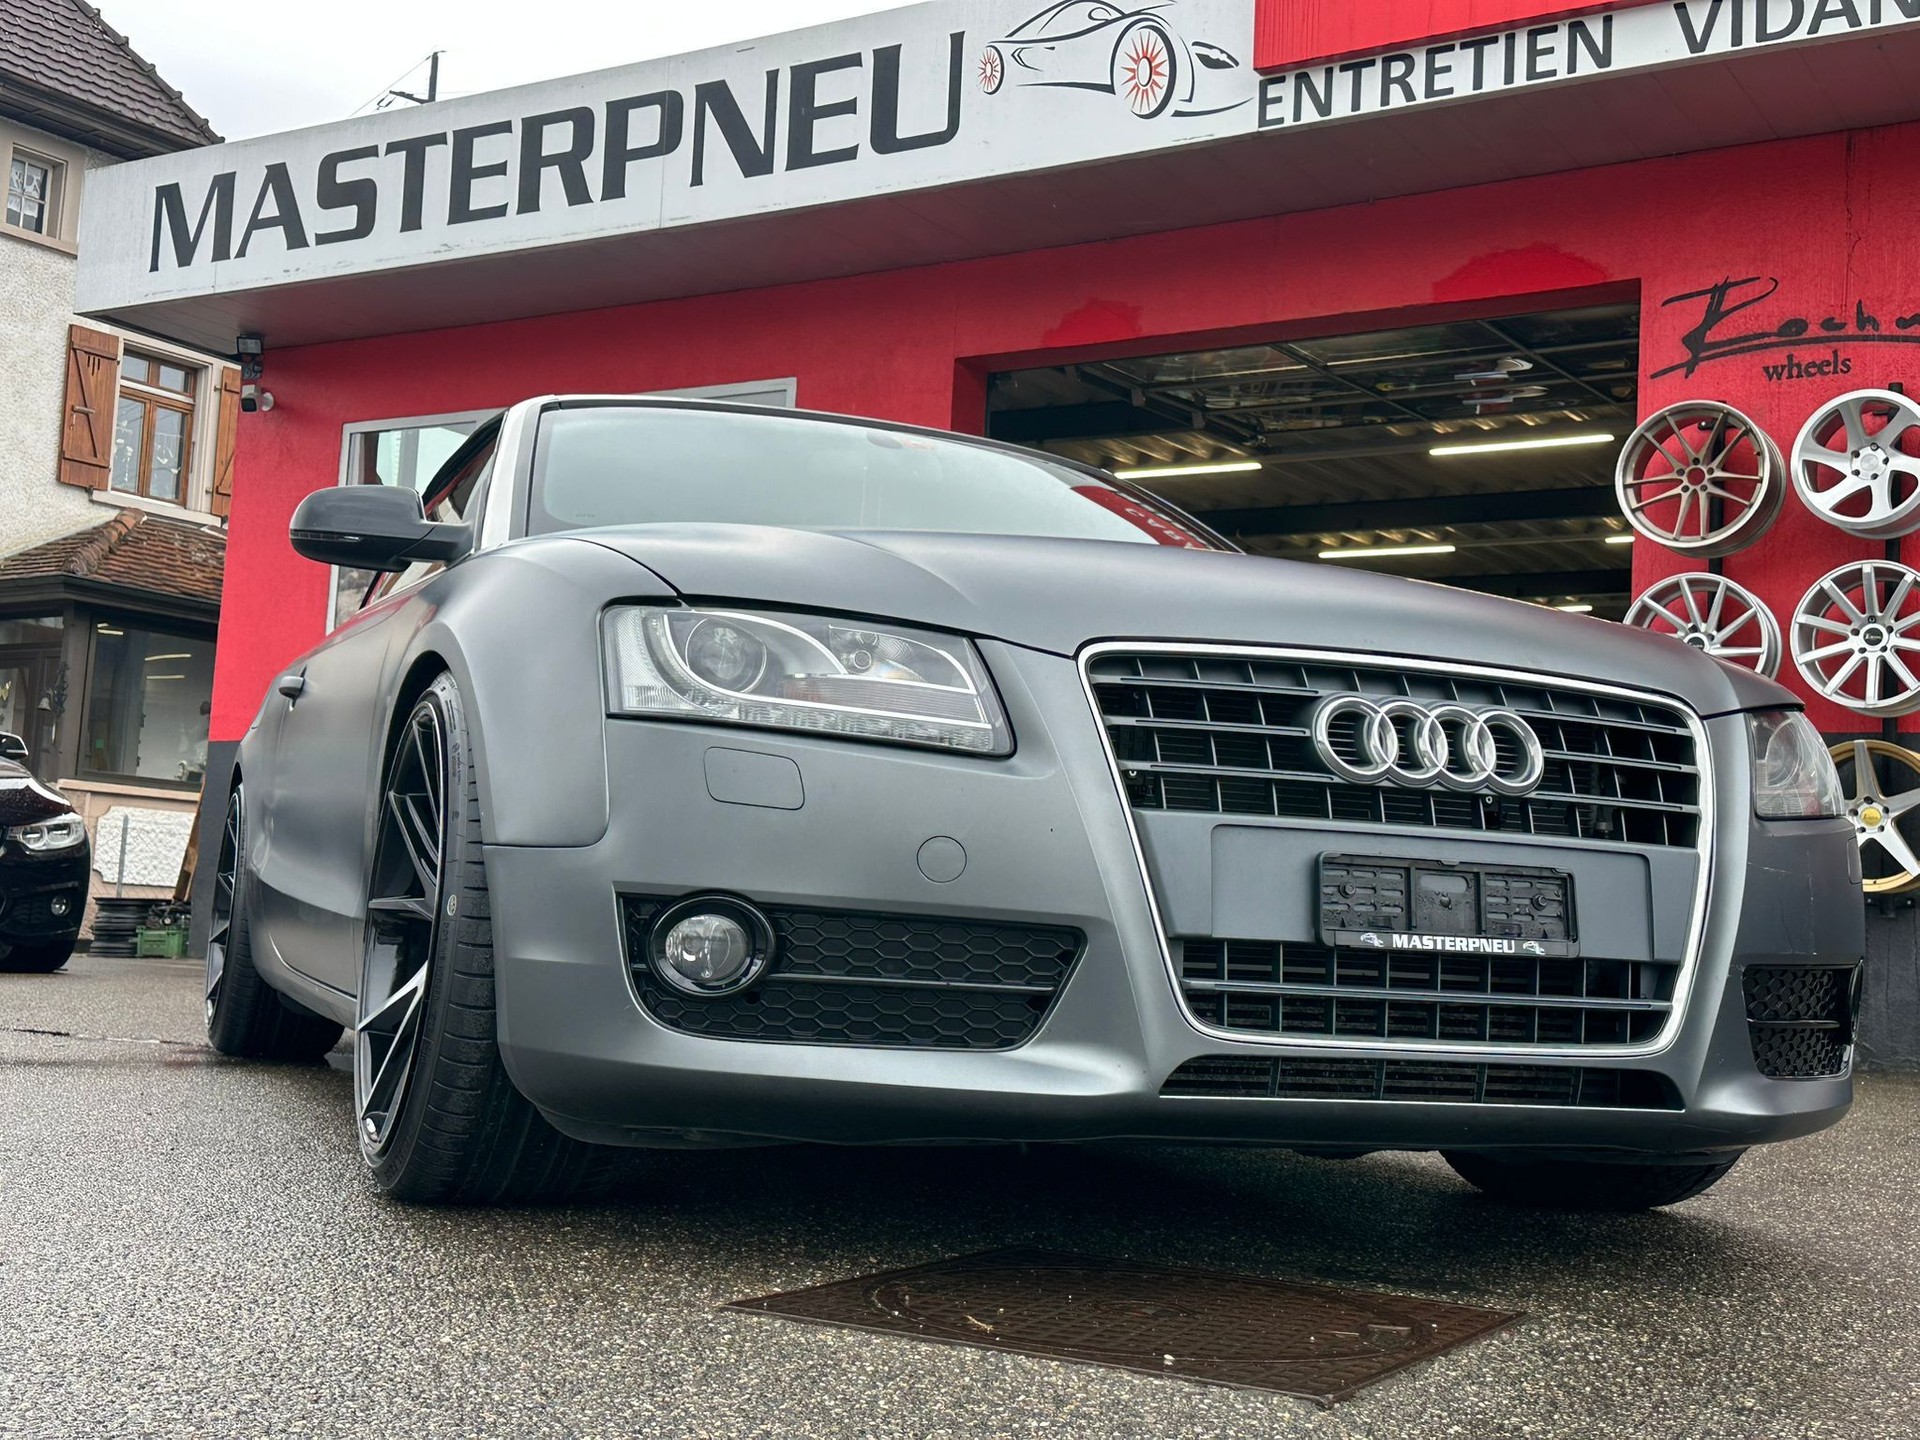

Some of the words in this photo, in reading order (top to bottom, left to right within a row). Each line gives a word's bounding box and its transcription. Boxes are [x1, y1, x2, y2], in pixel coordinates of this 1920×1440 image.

[1258, 15, 1613, 129] ENTRETIEN
[150, 32, 966, 272] MASTERPNEU
[1762, 349, 1852, 382] wheels
[1392, 934, 1515, 953] MASTERPNEU
